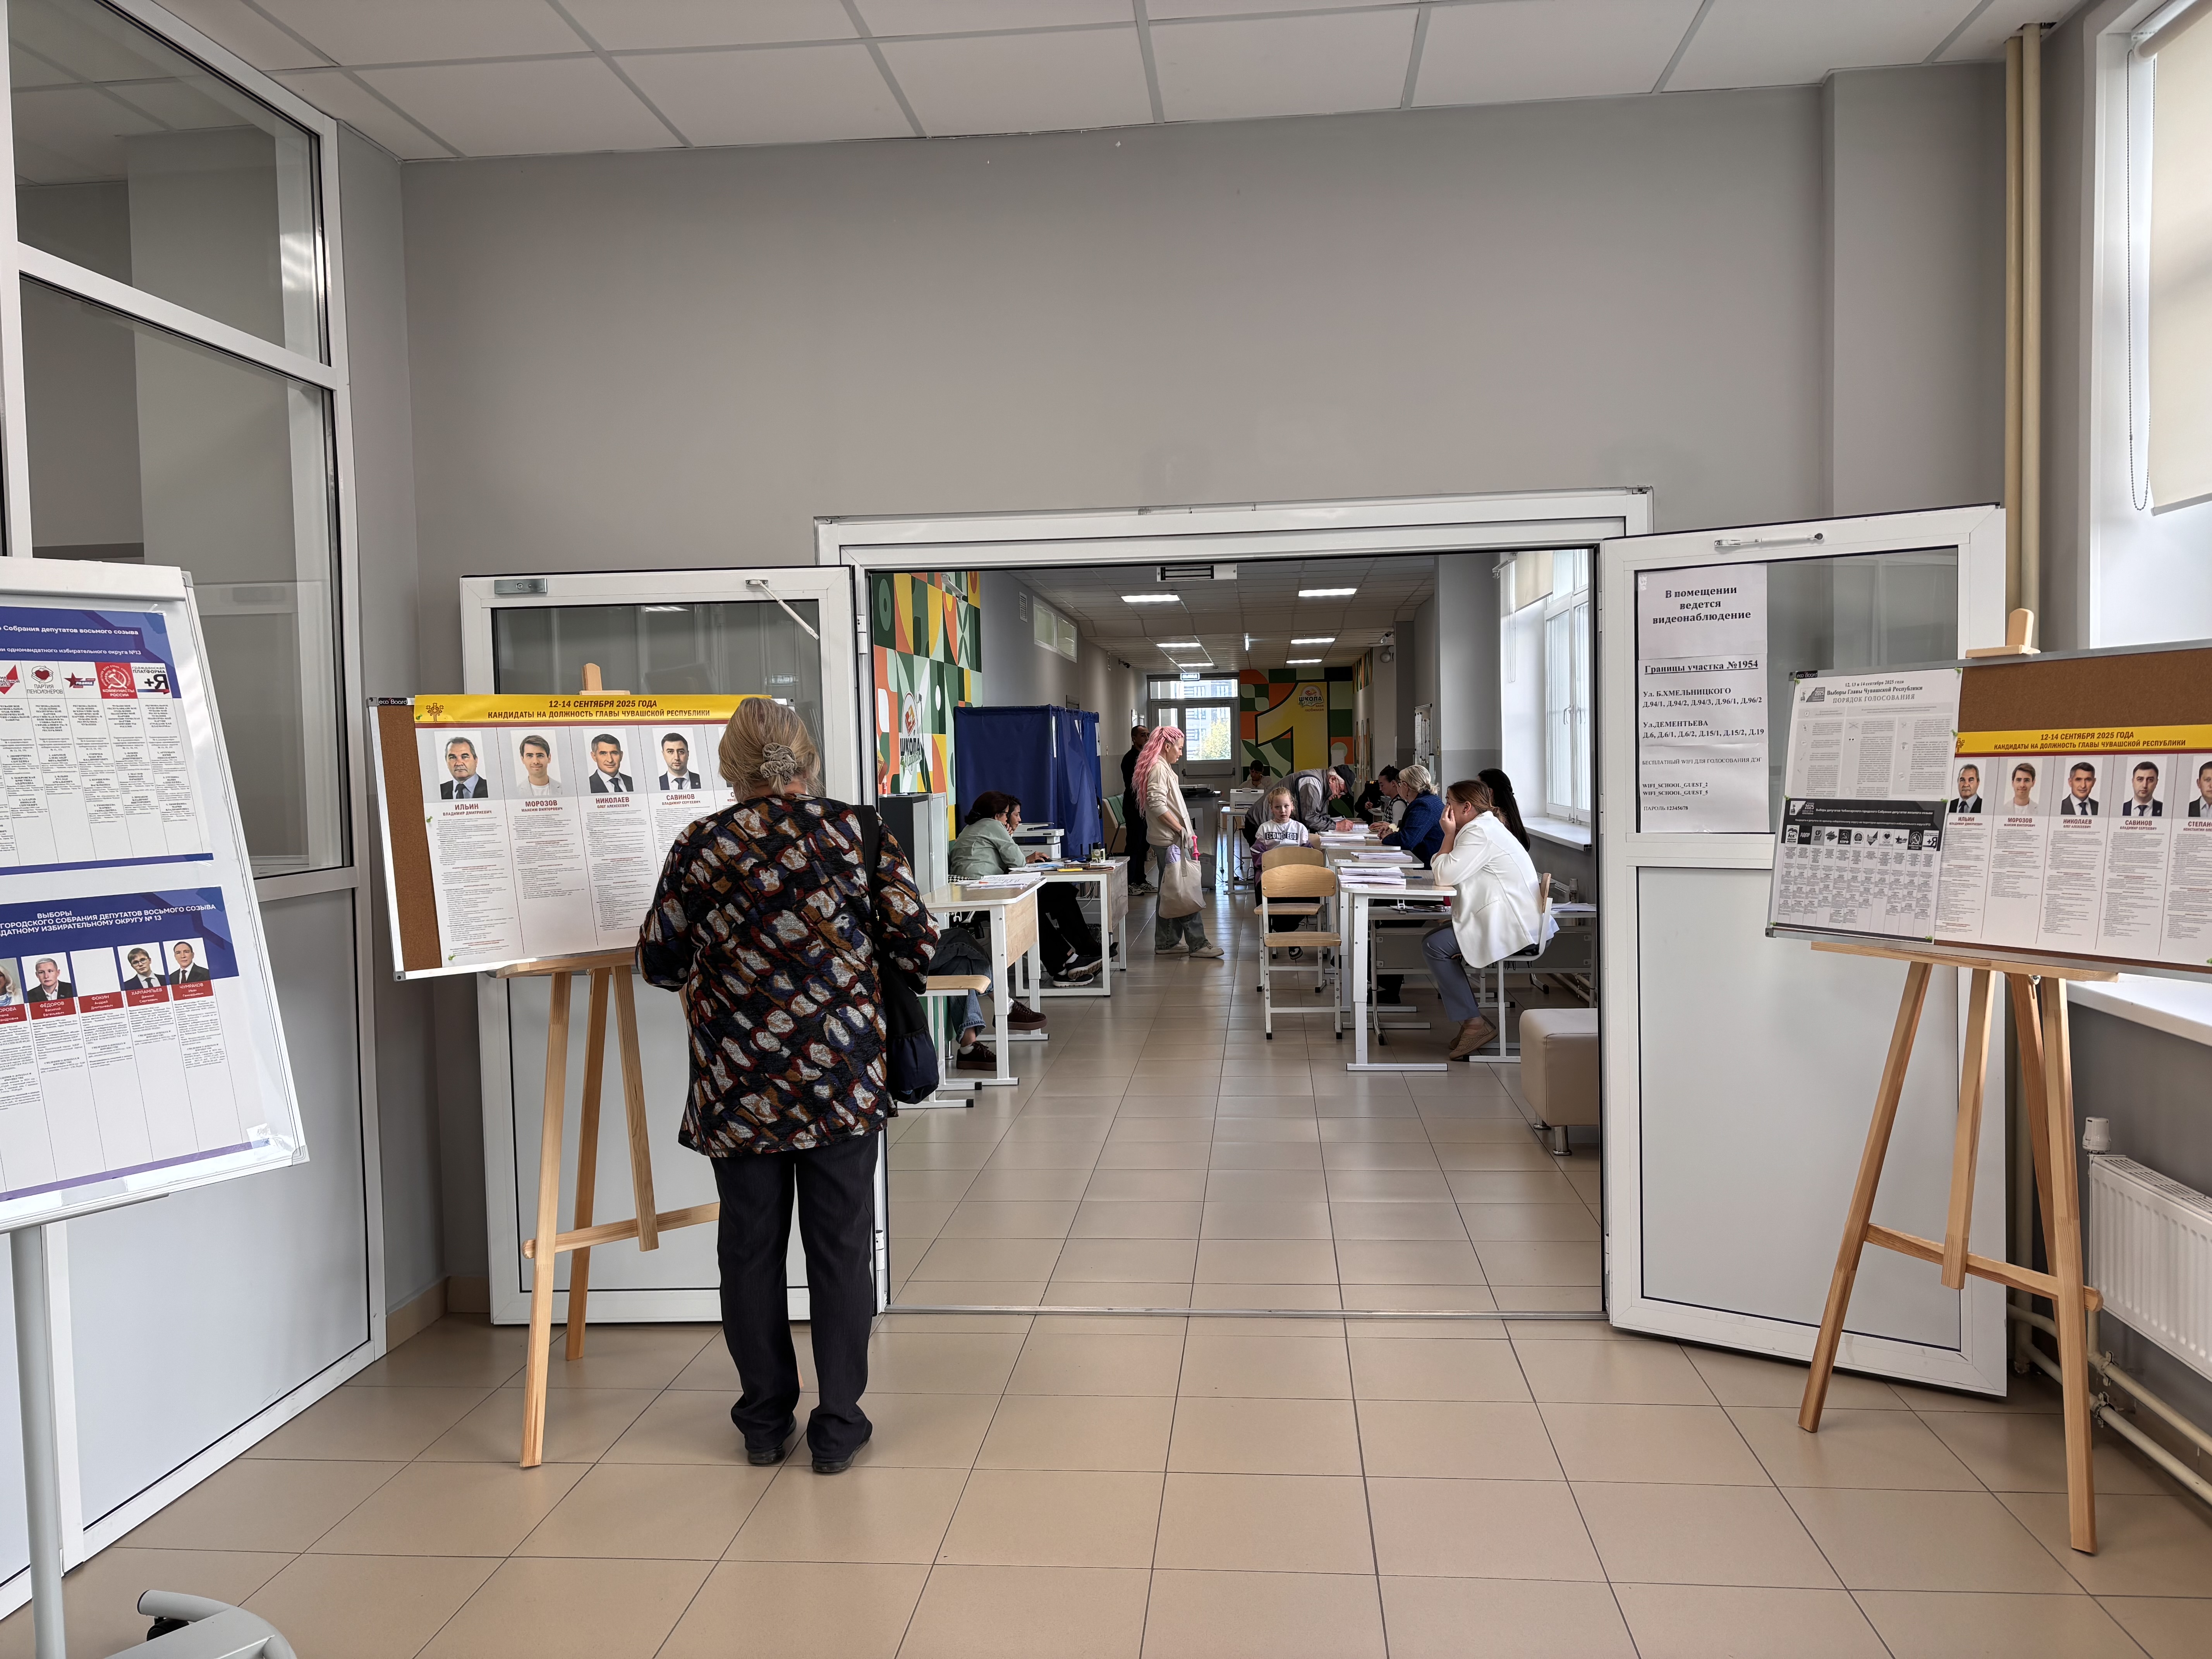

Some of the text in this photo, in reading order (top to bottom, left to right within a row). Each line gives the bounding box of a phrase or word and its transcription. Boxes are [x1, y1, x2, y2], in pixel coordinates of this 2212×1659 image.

[1674, 587, 1737, 598] помещении
[1680, 601, 1721, 610] ведется
[1652, 611, 1752, 625] видеонаблюдение
[1645, 660, 1759, 674] Границы участка №1954
[1656, 687, 1731, 697] Б.ХМЕЛЬНИЦКОГО
[1864, 694, 1915, 702] ГОЛОСОВАНИЯ
[638, 700, 657, 708] ГОДА
[1643, 720, 1708, 728] Ул.ДЕМЕНТЬЕВА
[900, 738, 921, 756] ШКОЛА
[0, 919, 53, 929] ГОРОДСКОГО
[55, 915, 98, 924] СОБРАНИЯ
[100, 911, 142, 921] ДЕПУТАТОВ
[144, 907, 184, 915] ВОСЬМОГО
[37, 910, 72, 919] ВЫБОРЫ
[0, 927, 39, 937] ДАТНОМУ
[41, 920, 113, 932] ИЗБИРАТЕЛЬНОМУ
